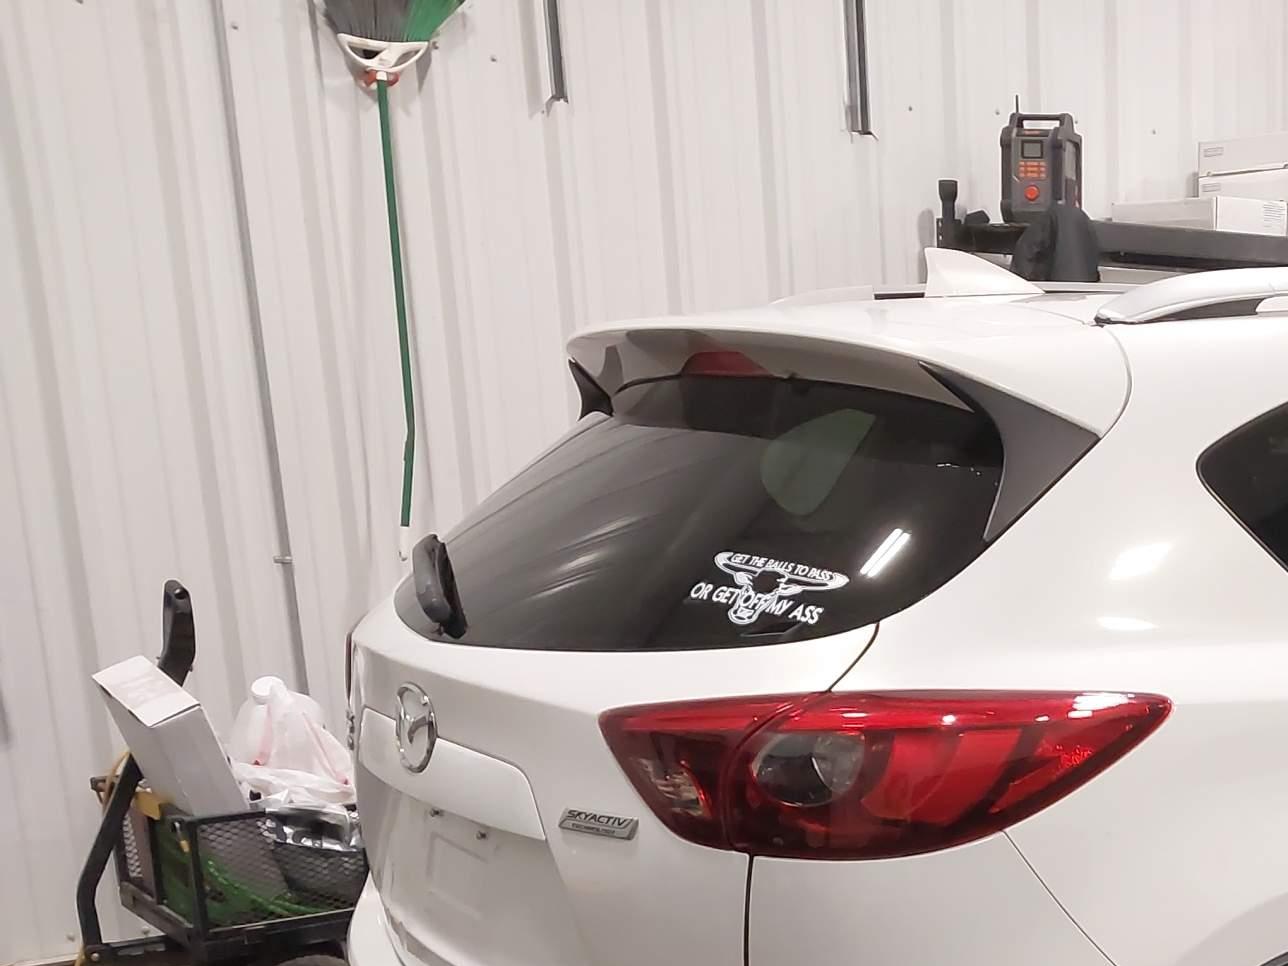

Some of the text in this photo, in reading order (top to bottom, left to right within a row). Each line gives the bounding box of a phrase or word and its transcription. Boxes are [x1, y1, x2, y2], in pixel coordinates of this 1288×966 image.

[731, 554, 833, 581] GET THE BALLS TO PASS
[690, 582, 825, 624] OR GET OFF MY ASS
[566, 809, 628, 826] SKYACTIV
